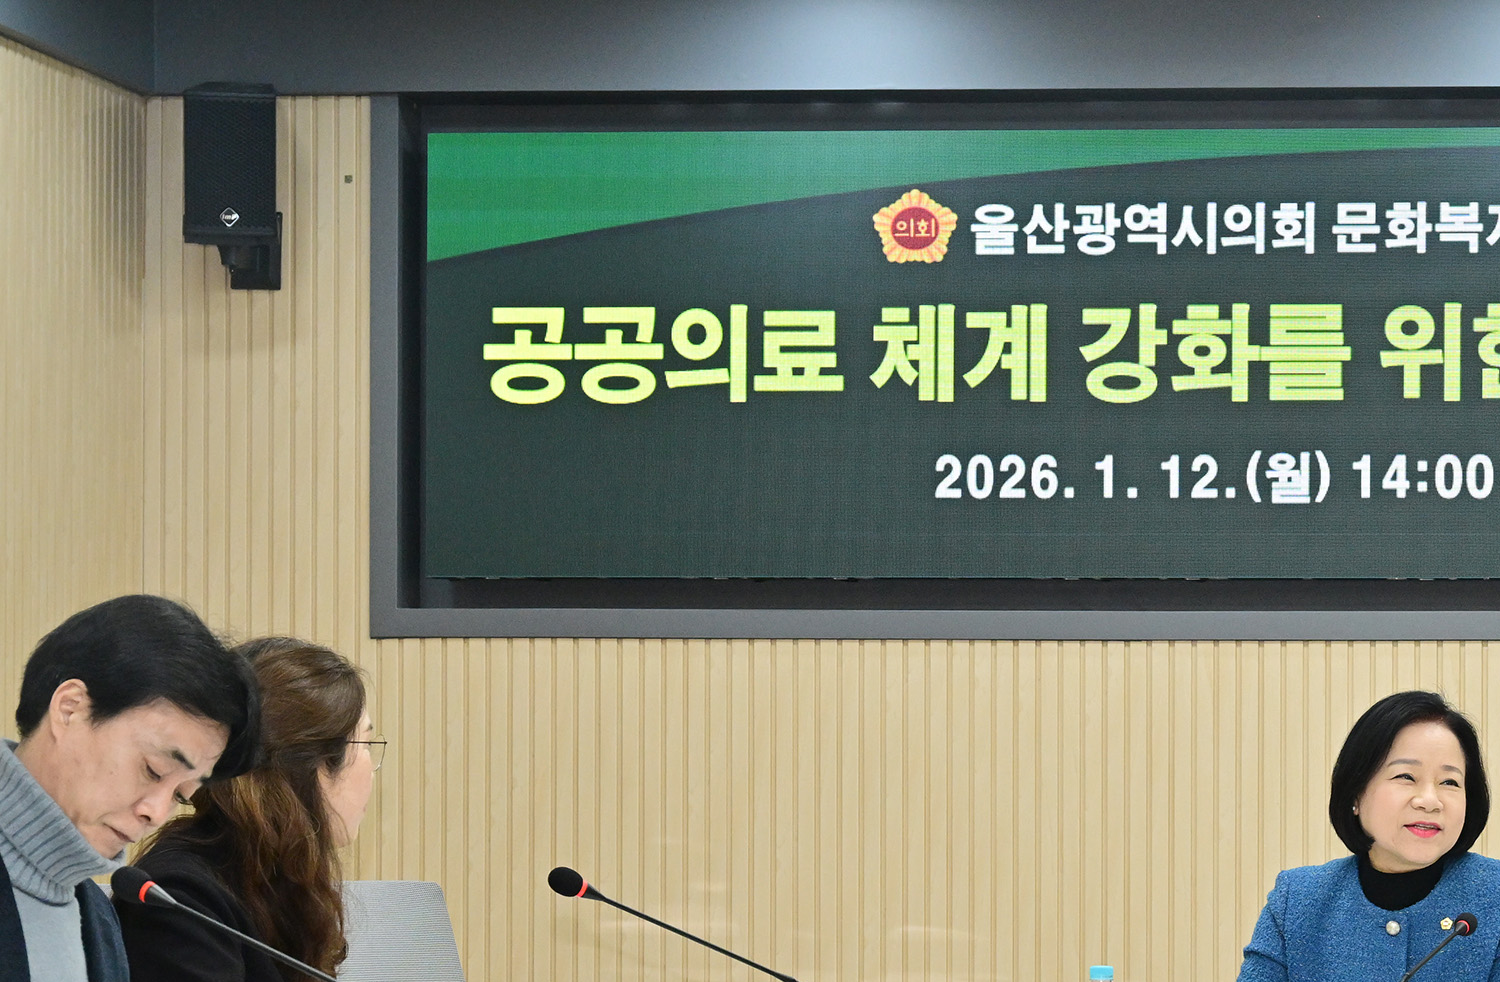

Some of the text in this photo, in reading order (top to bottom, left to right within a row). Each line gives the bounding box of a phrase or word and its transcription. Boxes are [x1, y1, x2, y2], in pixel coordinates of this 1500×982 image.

[893, 217, 936, 238] 의회
[971, 202, 1315, 255] 울산광역시의회
[484, 305, 843, 404] 공공의료
[870, 304, 1047, 402] 체계
[1079, 304, 1351, 403] 강화를
[935, 451, 1493, 503] 2026. 1. 12.(월) 14:00
